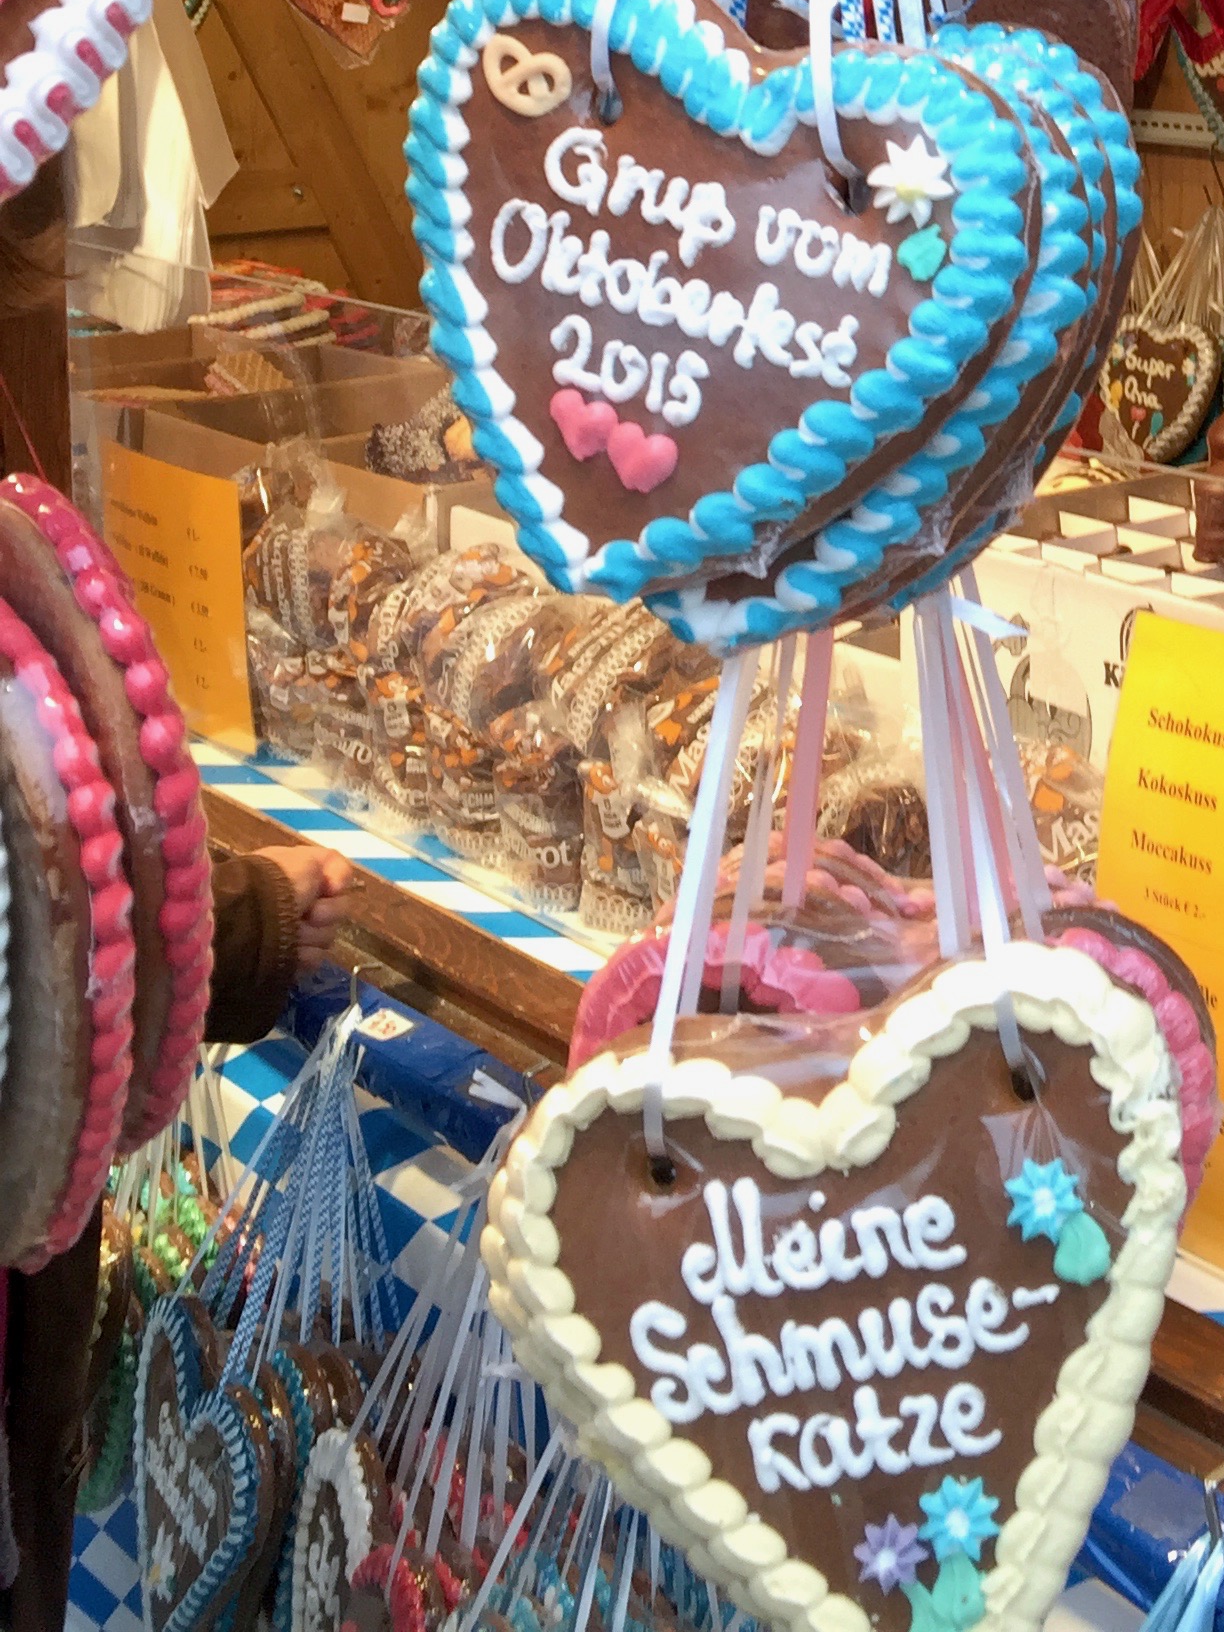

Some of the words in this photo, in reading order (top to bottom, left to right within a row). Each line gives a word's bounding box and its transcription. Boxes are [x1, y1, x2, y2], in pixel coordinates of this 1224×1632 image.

[491, 196, 860, 389] Oktoberfest
[755, 205, 892, 299] vom
[549, 314, 710, 427] 2015
[1137, 767, 1218, 812] Kokoskuss
[1131, 828, 1212, 875] Moccakuss
[681, 1175, 968, 1304] Meine
